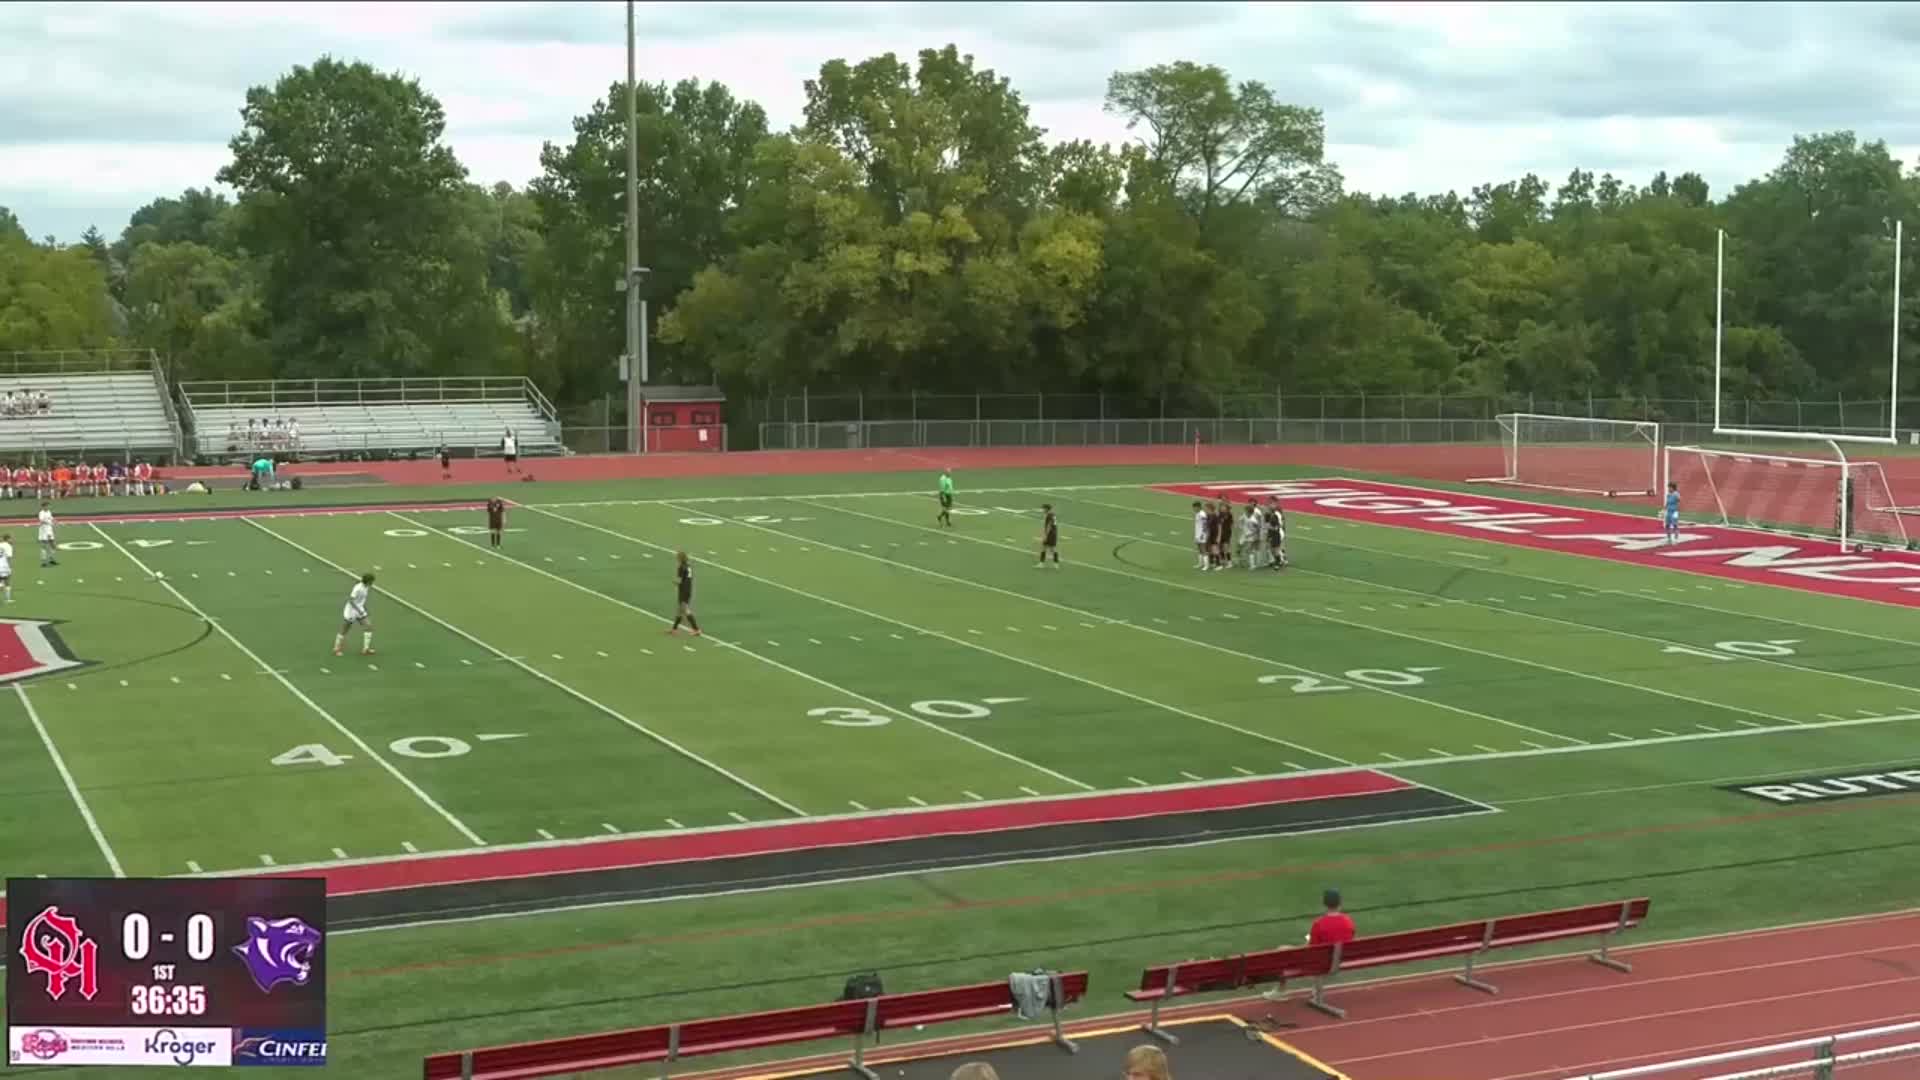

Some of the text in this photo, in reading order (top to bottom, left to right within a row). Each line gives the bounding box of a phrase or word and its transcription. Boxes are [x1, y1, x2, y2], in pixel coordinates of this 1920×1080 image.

[1200, 483, 1920, 592] HIGHLAND
[1257, 669, 1425, 693] 20
[807, 700, 991, 727] 30
[271, 736, 472, 766] 40
